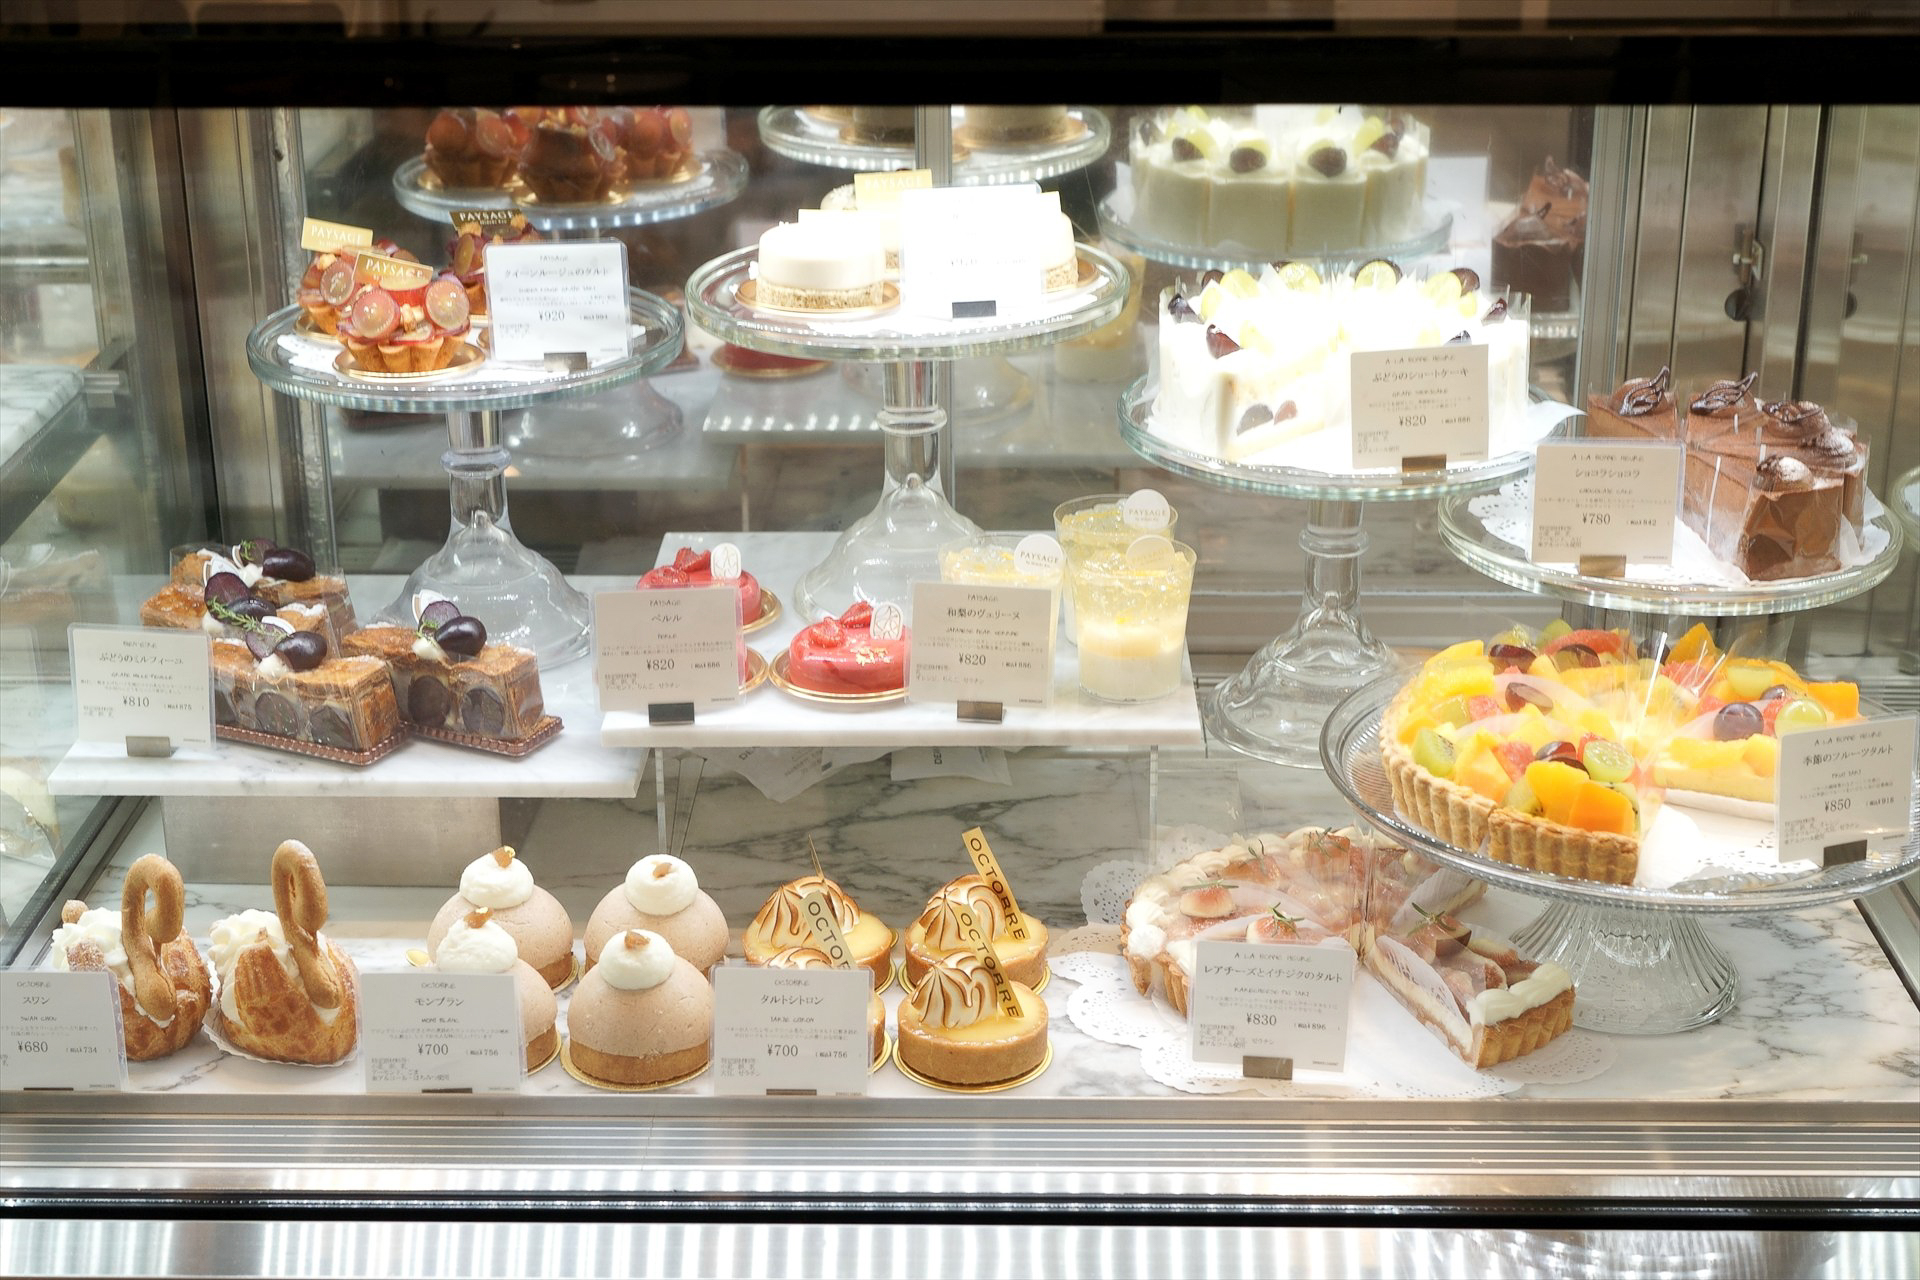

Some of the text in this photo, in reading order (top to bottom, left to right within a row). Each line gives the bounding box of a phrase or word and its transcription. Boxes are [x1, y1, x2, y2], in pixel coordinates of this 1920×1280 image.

[460, 211, 514, 222] PAYSAGE
[311, 224, 361, 244] PAYSAGE
[366, 258, 424, 277] PAYSAGE
[538, 310, 565, 322] ¥920
[1373, 367, 1469, 383] ぶどうのショートケーキ
[1399, 415, 1427, 427] ¥820
[1575, 468, 1640, 479] ショコラショコラ
[1128, 508, 1166, 517] PAYSAGE
[1582, 513, 1611, 525] ¥780
[1020, 551, 1059, 564] PAYSAGE
[99, 652, 184, 666] ぶどうのミルフィーユ
[646, 659, 675, 671] ¥820
[959, 653, 986, 666] ¥820
[123, 695, 150, 708] ¥810
[1803, 744, 1894, 767] 季節のフルーツタルト
[1824, 798, 1851, 813] ¥850
[970, 837, 1026, 940] OCTOBRE
[960, 912, 1019, 1018] OCTOBRE
[1204, 965, 1343, 983] レアチーズとイチジクのタルト
[23, 996, 50, 1005] スワン
[415, 996, 464, 1007] モンブラン
[760, 994, 824, 1005] タルトシトロン
[1246, 1013, 1277, 1026] ¥830
[18, 1040, 48, 1053] ¥680
[417, 1043, 449, 1056] ¥700
[767, 1044, 799, 1057] ¥700
